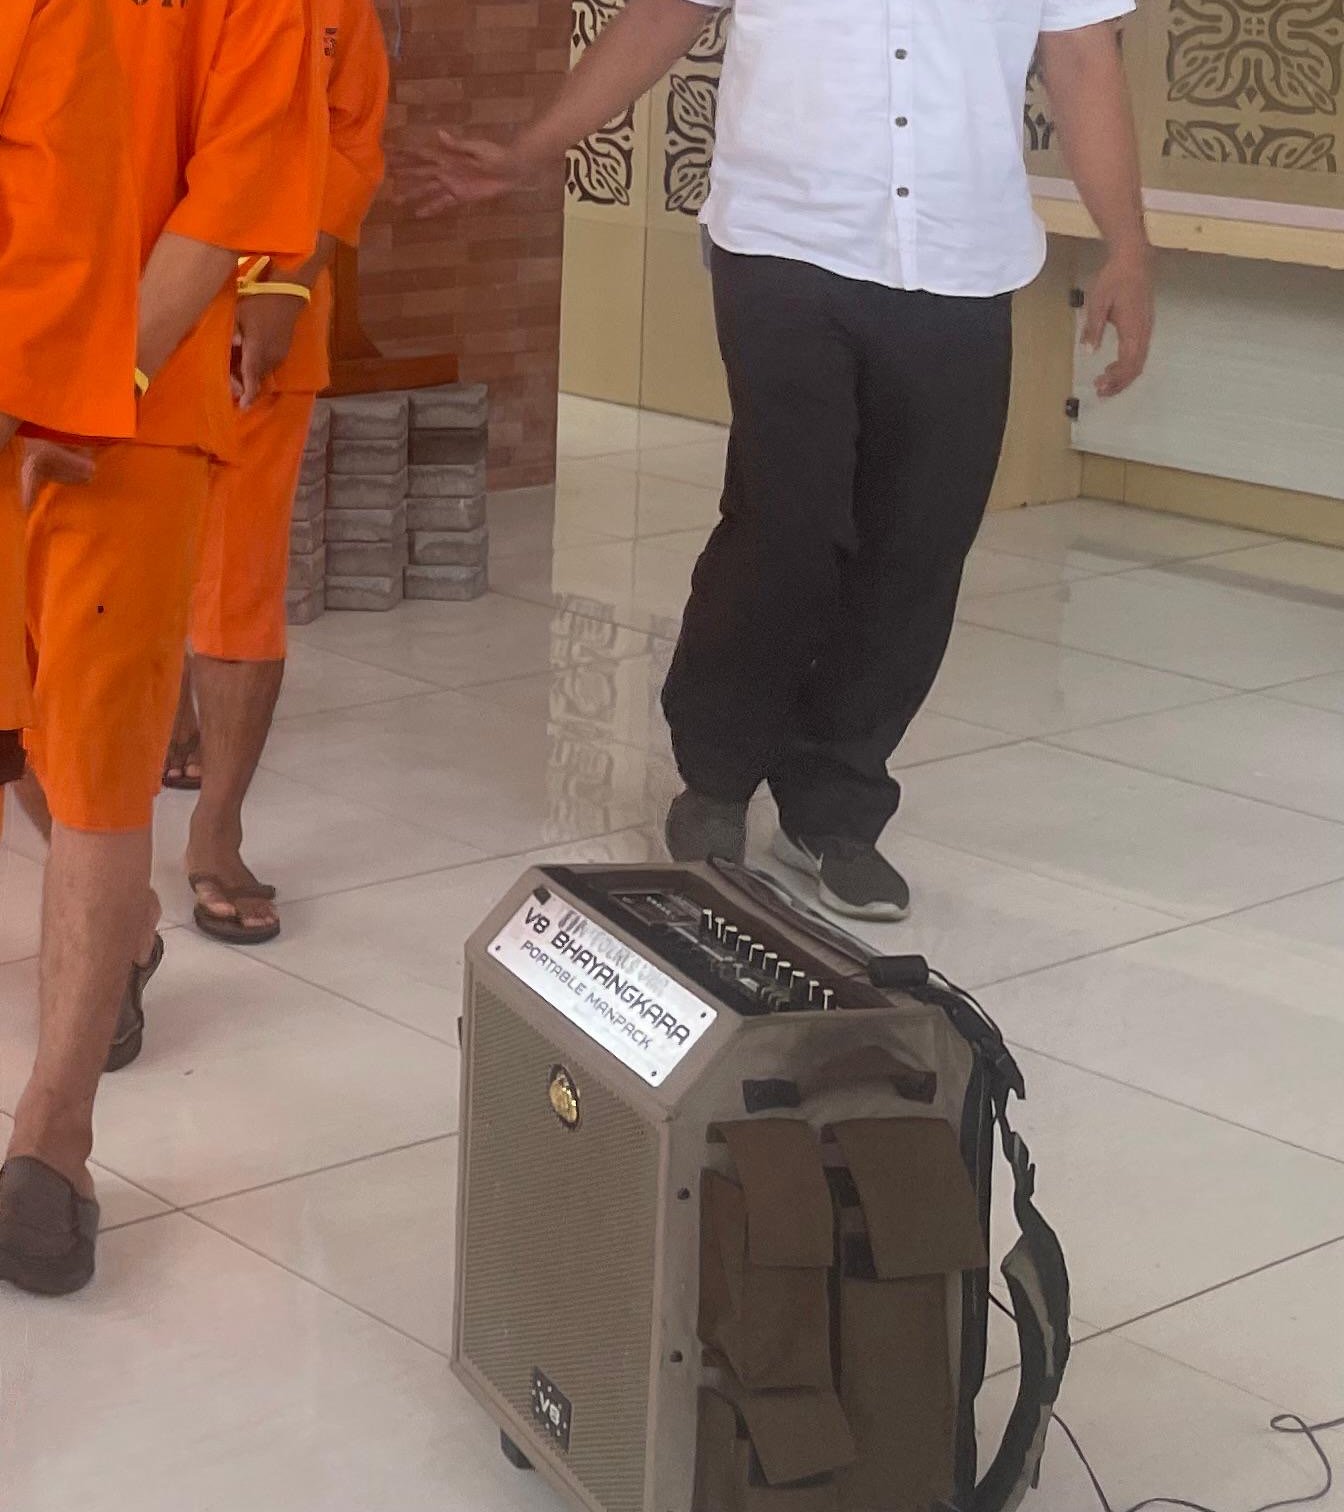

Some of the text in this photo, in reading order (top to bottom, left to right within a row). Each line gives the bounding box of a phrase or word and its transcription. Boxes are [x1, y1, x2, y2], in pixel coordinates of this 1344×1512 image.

[520, 940, 587, 996] PORTABLE
[586, 991, 653, 1050] MANPACK
[524, 906, 551, 935] V8
[551, 930, 691, 1046] BHAYANGKARA
